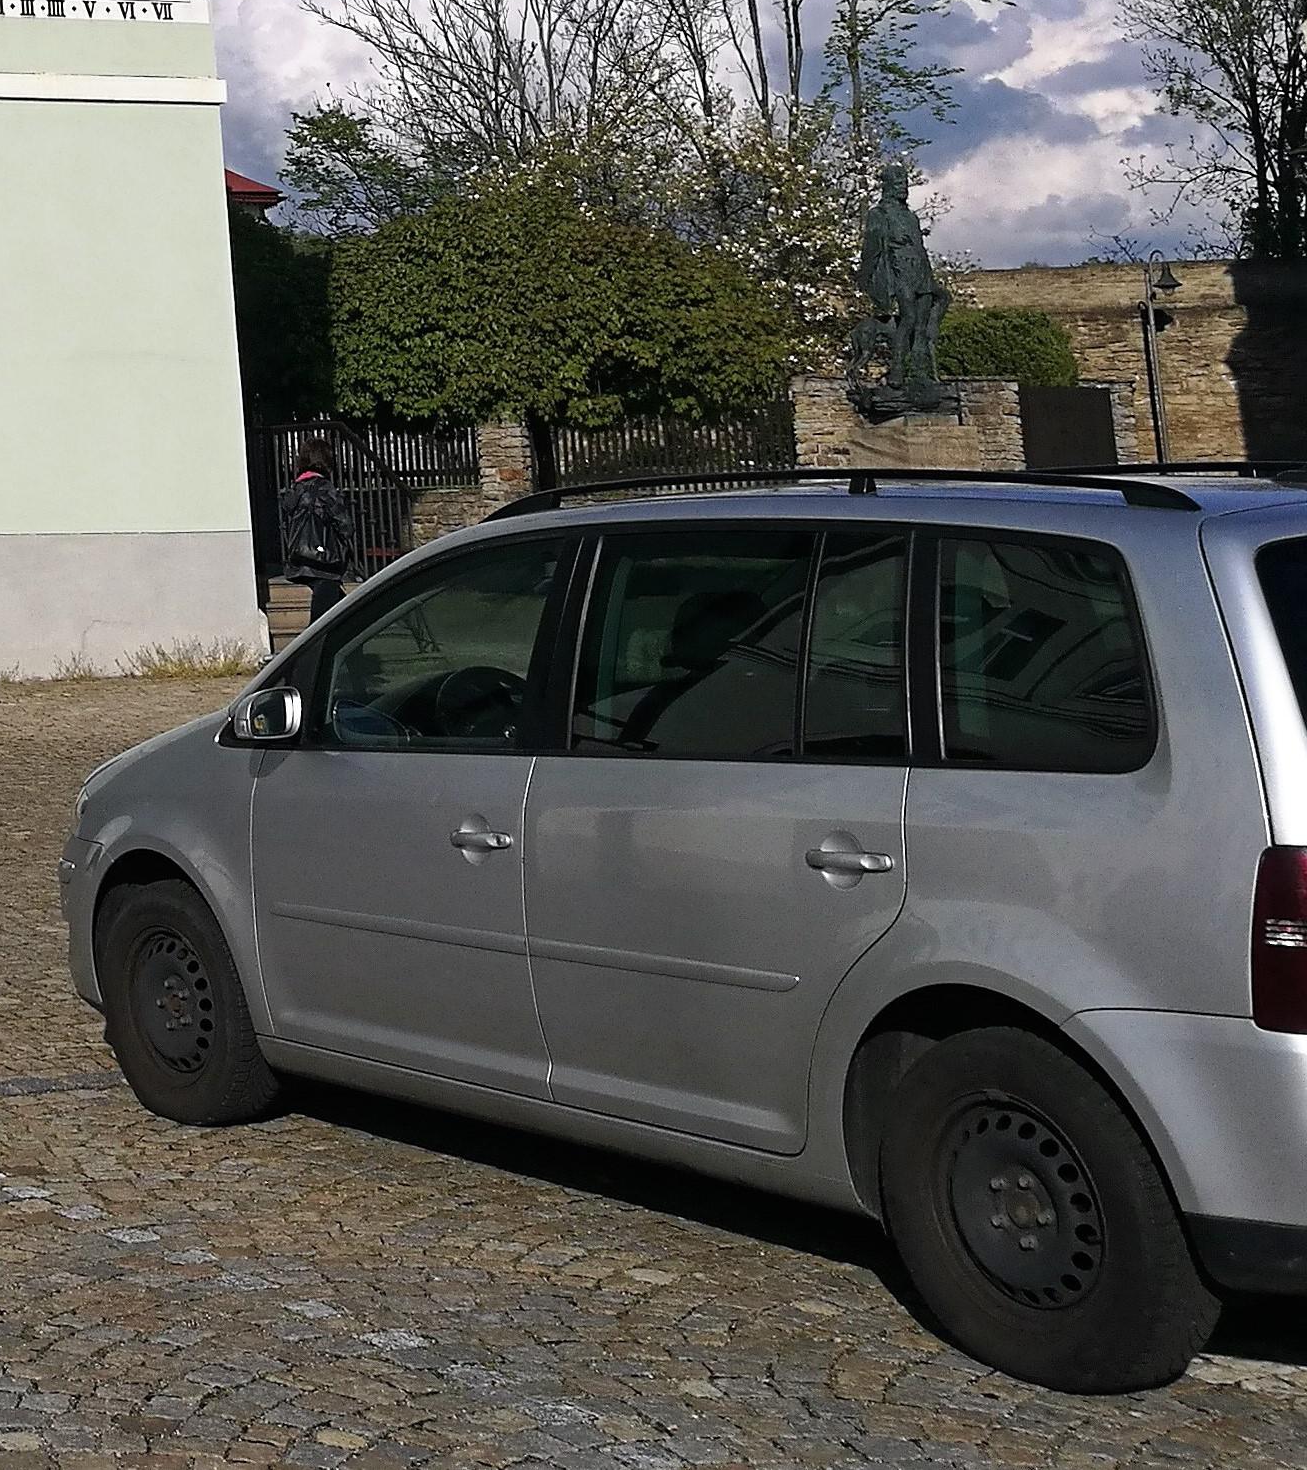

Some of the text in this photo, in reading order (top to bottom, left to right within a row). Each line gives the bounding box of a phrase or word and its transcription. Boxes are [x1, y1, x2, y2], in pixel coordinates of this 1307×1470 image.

[47, 0, 66, 17] IIII
[83, 0, 96, 18] V
[117, 1, 136, 20] VI
[152, 2, 173, 21] VII
